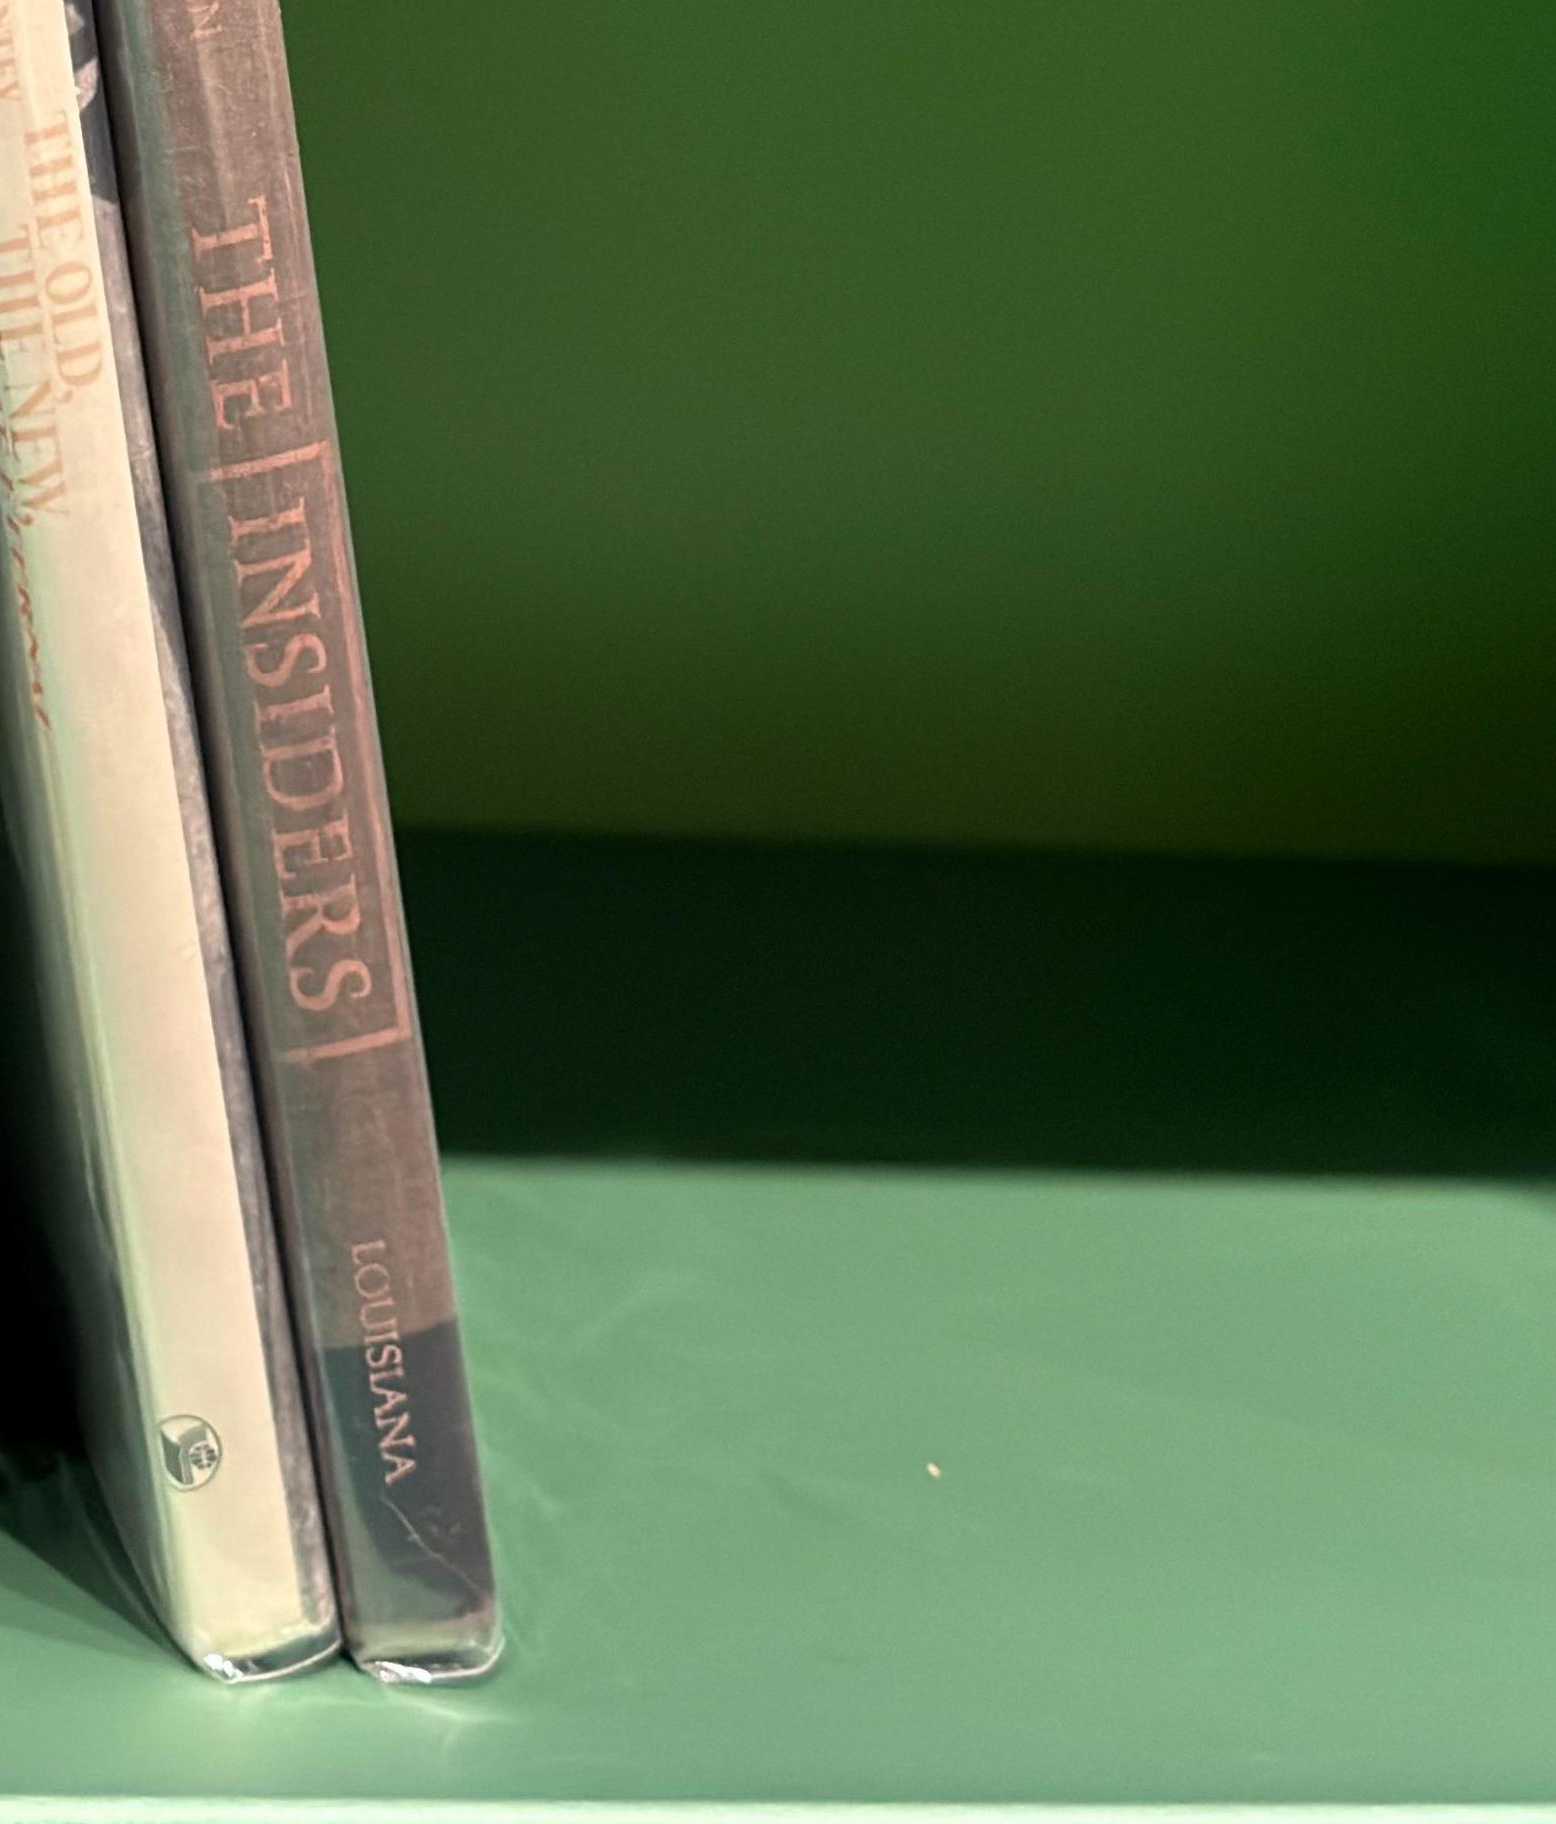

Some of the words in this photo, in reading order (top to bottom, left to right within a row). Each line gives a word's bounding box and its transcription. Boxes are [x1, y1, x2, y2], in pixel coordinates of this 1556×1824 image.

[190, 198, 292, 431] THE
[229, 499, 373, 1012] INSIDERS
[351, 1240, 415, 1486] LOUISIANA
